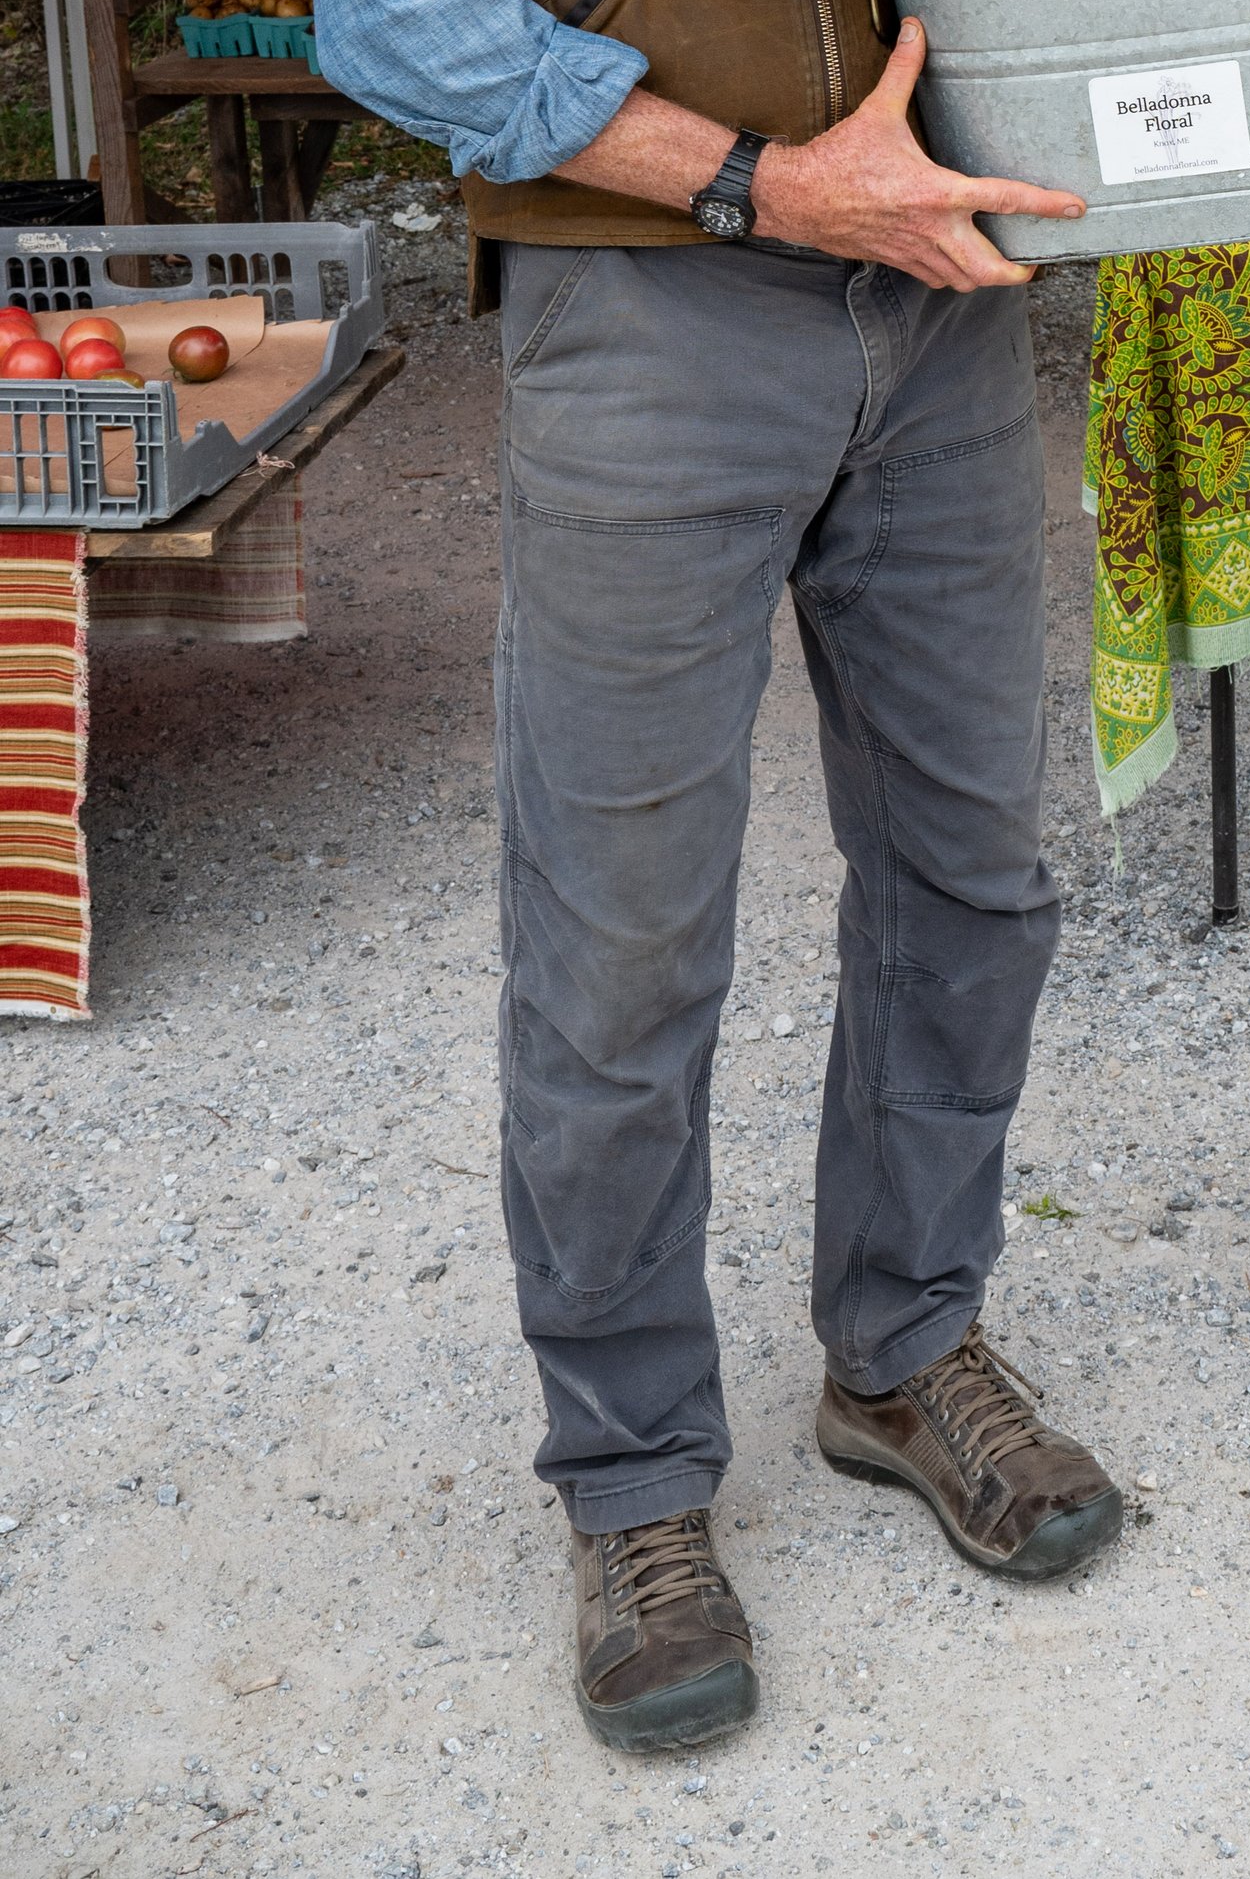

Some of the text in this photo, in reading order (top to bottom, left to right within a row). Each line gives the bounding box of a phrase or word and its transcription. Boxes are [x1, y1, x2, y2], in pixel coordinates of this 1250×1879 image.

[1116, 93, 1213, 116] Belladonna
[1144, 112, 1194, 133] Floral
[1176, 136, 1190, 145] ME
[1133, 157, 1219, 175] belladonnafloral.com
